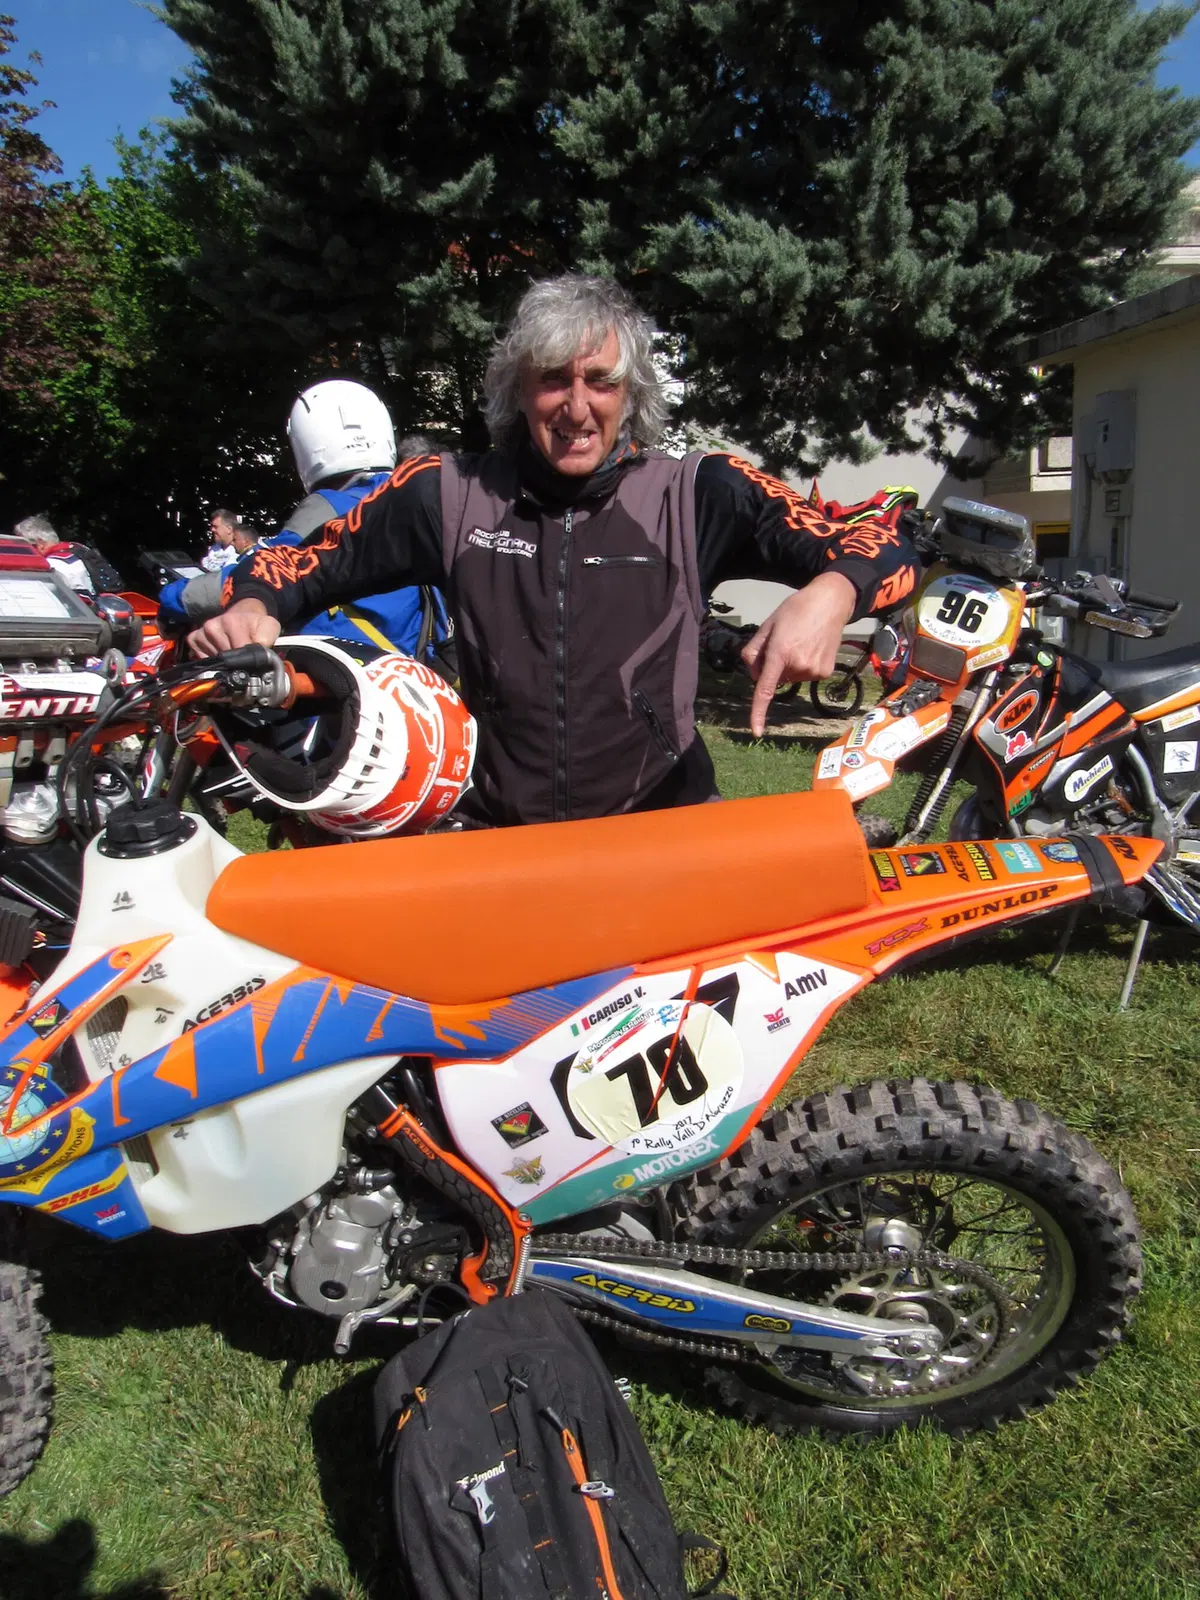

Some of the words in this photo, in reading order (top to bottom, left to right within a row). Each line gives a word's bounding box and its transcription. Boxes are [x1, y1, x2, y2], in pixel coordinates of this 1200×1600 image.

[936, 590, 989, 633] 96
[1003, 698, 1033, 727] KTM
[941, 883, 1058, 929] DUNLOP
[864, 917, 929, 956] TCX
[588, 993, 633, 1026] CARUSO
[634, 986, 647, 998] V.
[644, 1136, 675, 1150] Rally
[672, 1127, 696, 1142] Valli
[673, 1115, 694, 1131] 2017
[633, 1133, 720, 1182] MOTOREX
[48, 1185, 104, 1212] DHL
[572, 1273, 698, 1314] ACERBIS
